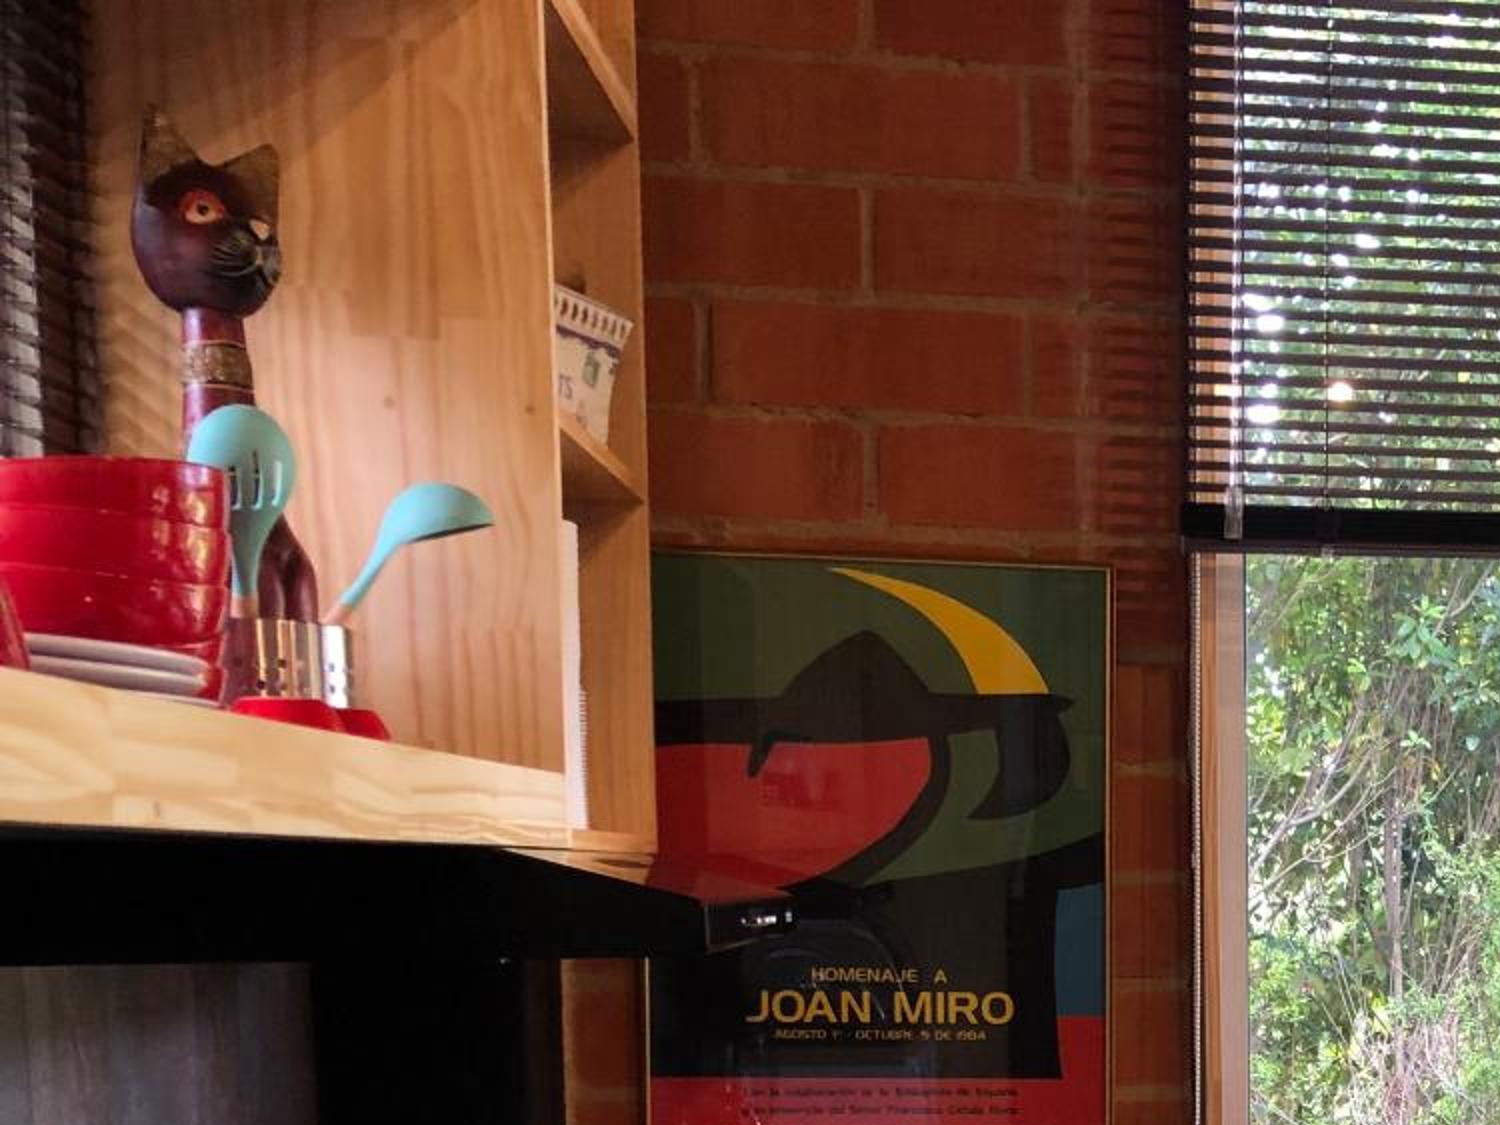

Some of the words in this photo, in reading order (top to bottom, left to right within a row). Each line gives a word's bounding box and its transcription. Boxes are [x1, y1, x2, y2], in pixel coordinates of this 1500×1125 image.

[811, 967, 919, 984] HOMENAJE
[934, 969, 949, 985] A
[745, 989, 872, 1024] JOAN
[893, 990, 1016, 1025] MIRO
[774, 1029, 827, 1041] AGOSTO
[855, 1029, 913, 1041] OCTUBRE
